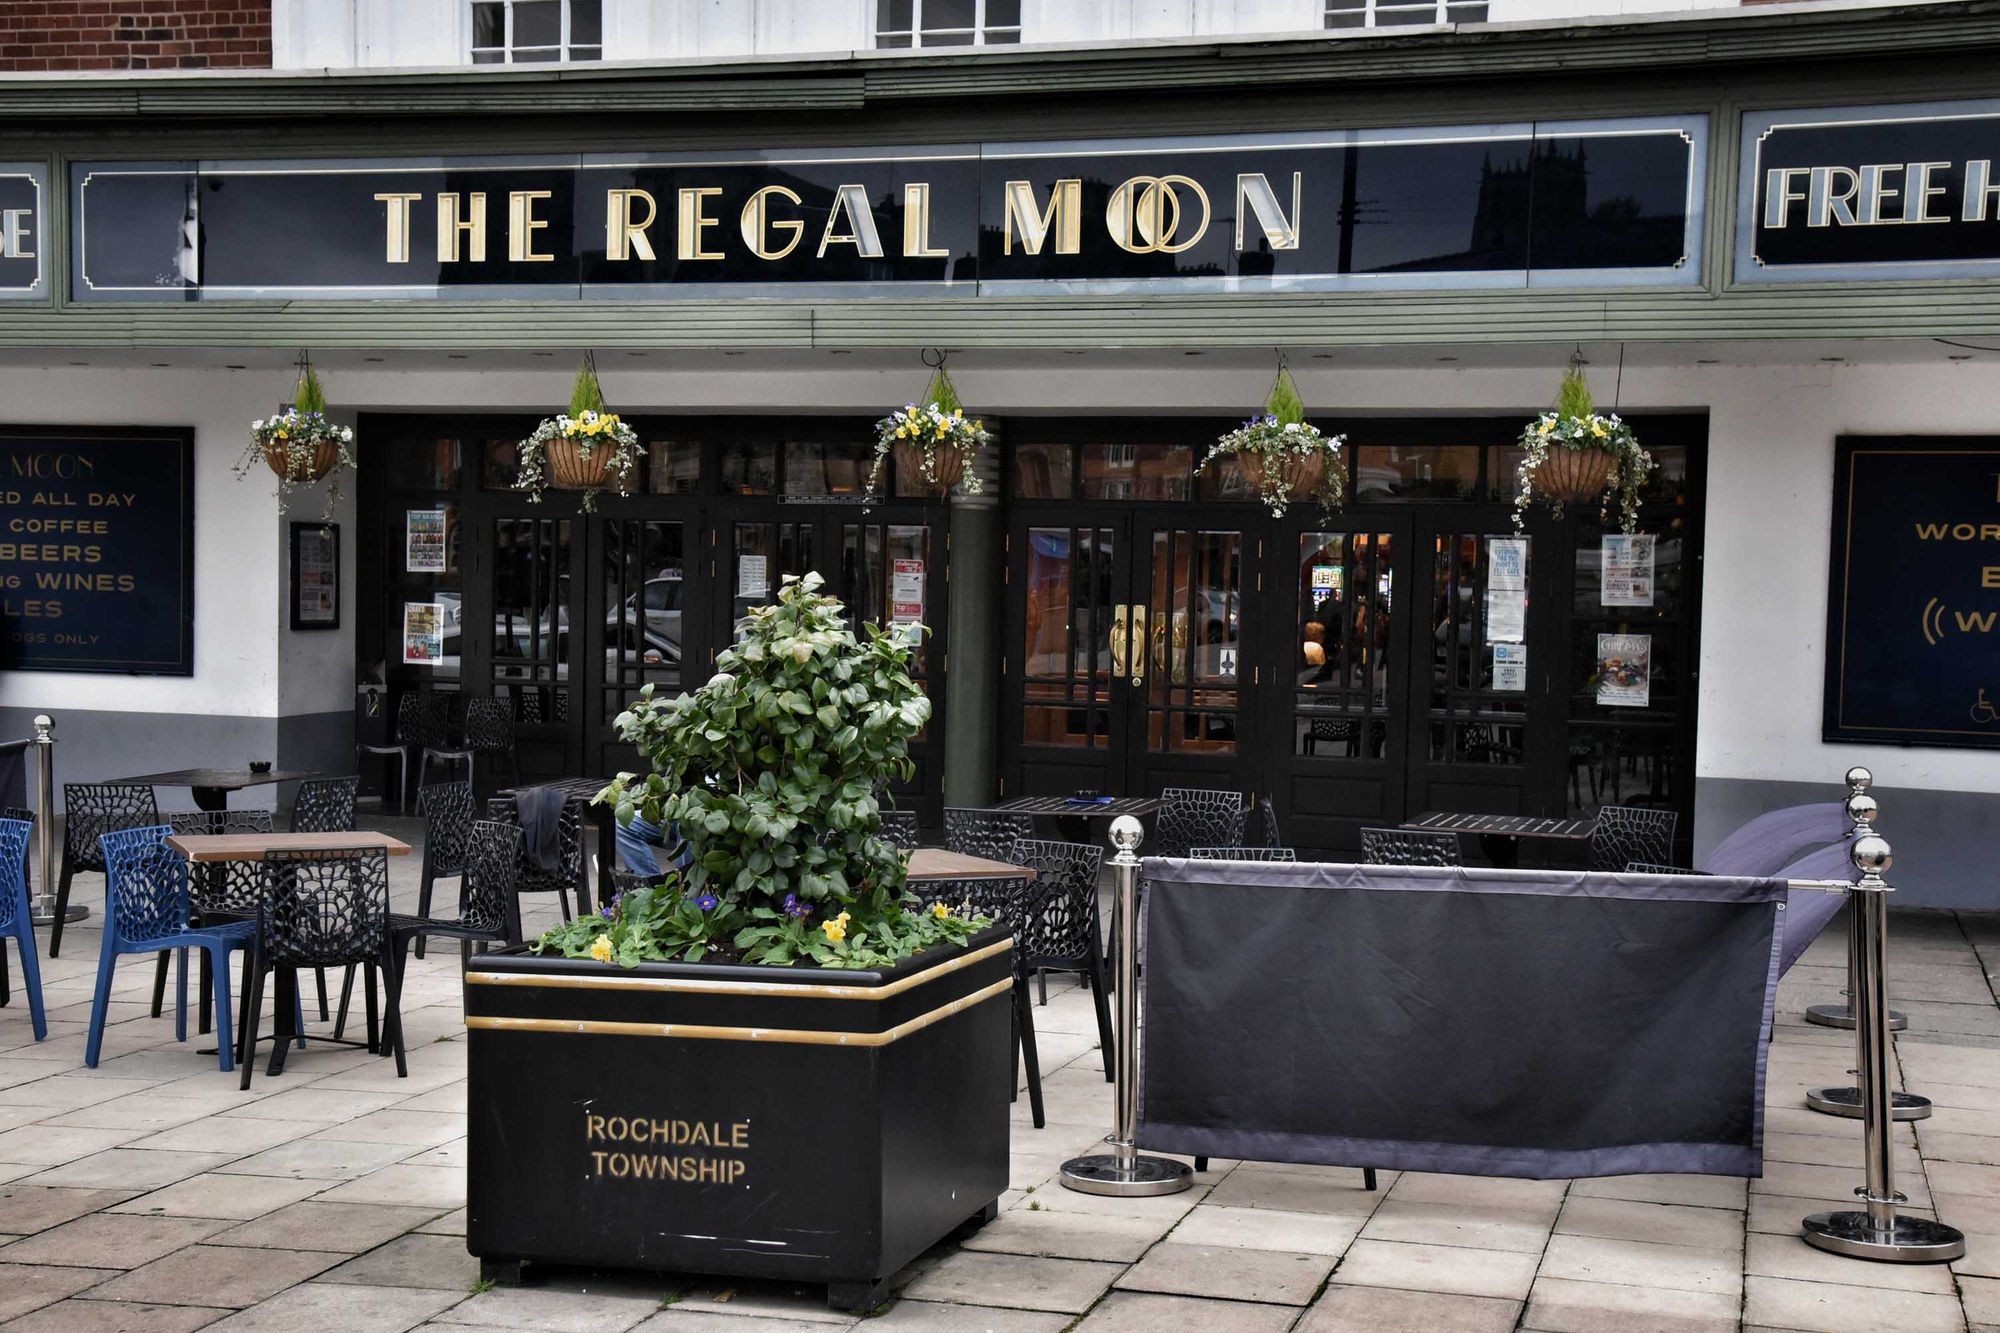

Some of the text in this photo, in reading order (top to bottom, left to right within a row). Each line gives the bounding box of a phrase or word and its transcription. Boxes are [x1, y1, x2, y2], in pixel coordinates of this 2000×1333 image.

[1763, 161, 1951, 229] FREE
[374, 171, 1302, 264] THE REGAL MOON
[0, 209, 36, 258] E
[11, 453, 95, 478] MOON
[0, 491, 136, 507] D ALL DAY
[9, 518, 109, 534] COFFEE
[0, 544, 102, 562] BEERS
[0, 572, 135, 592] G WINES
[7, 632, 100, 645] OGS ONLY
[587, 1114, 749, 1148] ROCHDALE
[592, 1151, 746, 1184] TOWNSHIP
